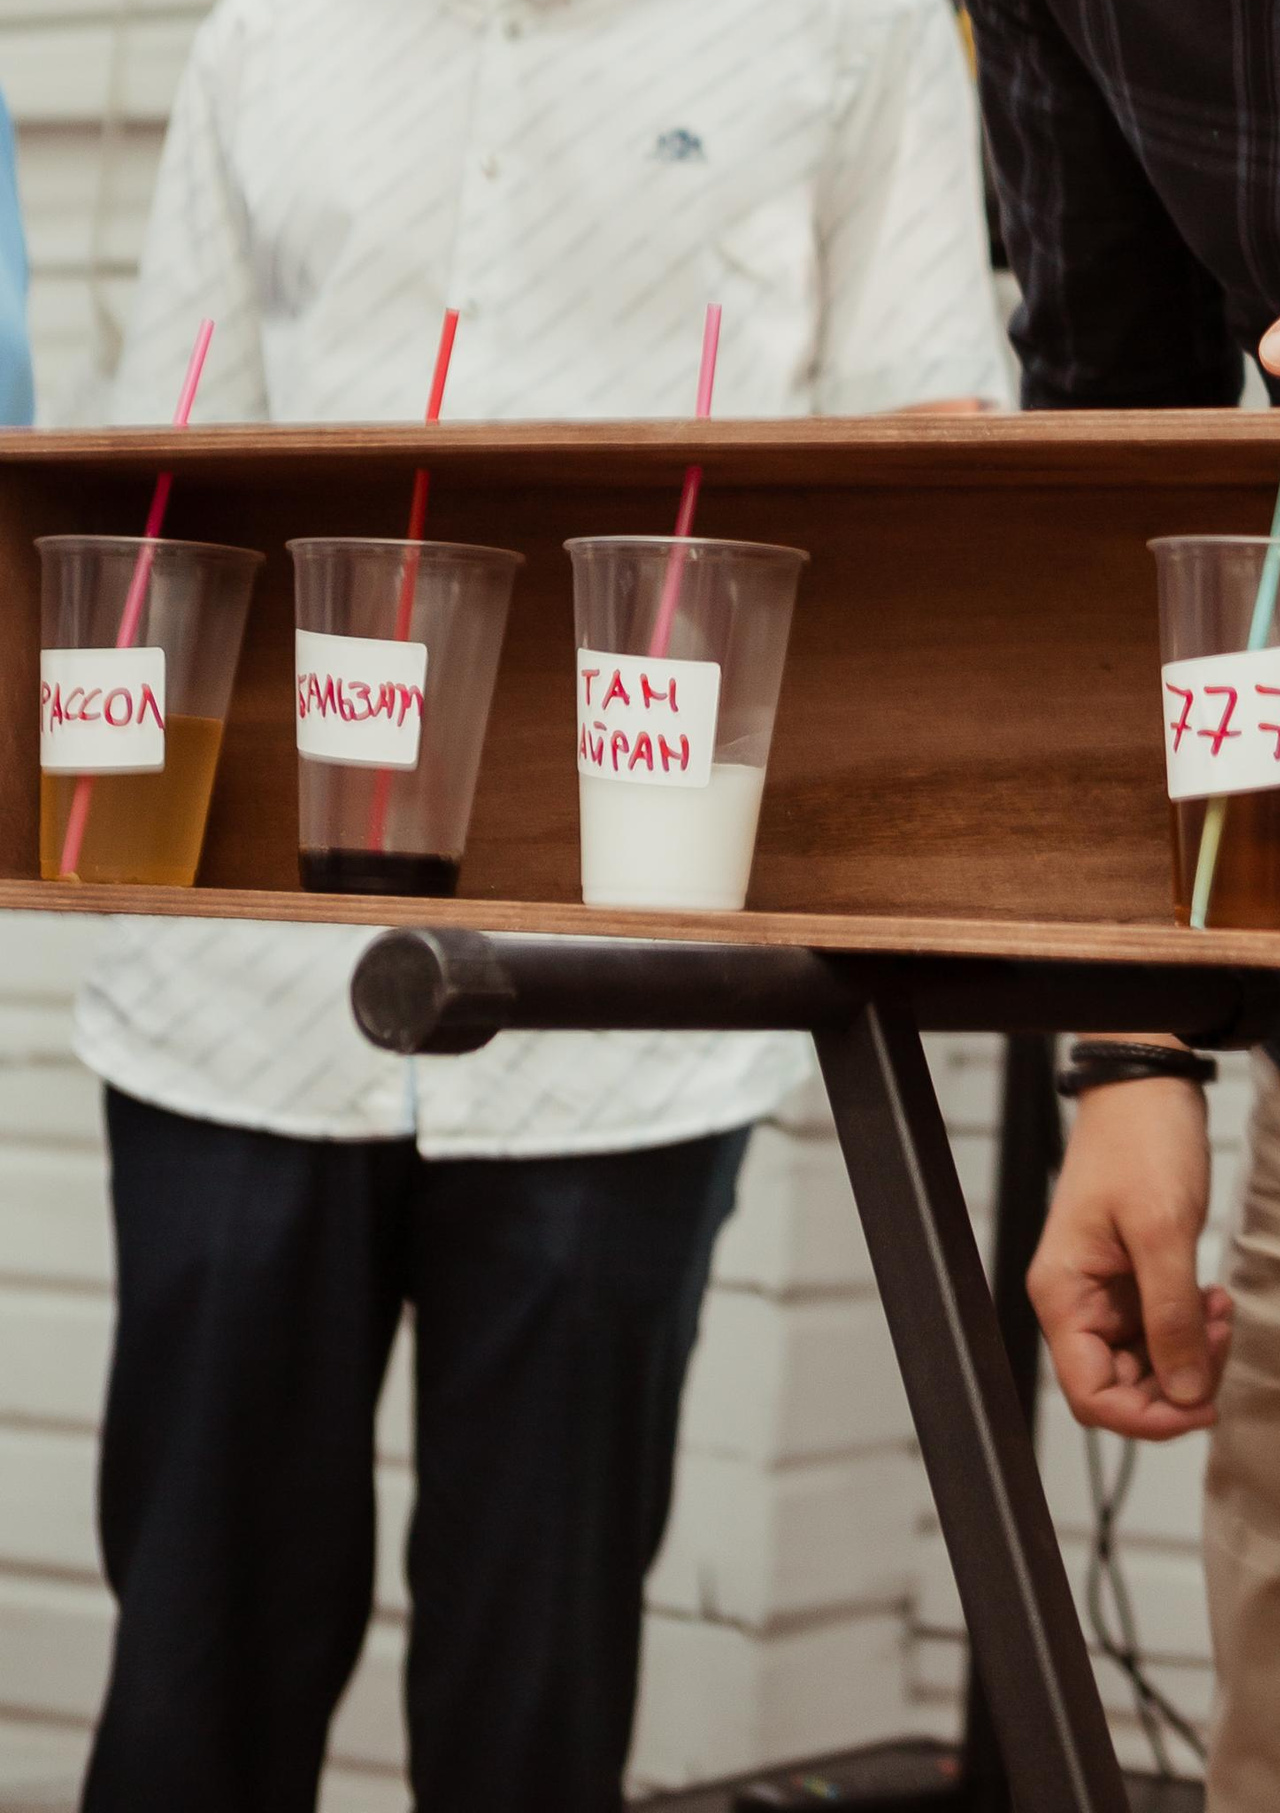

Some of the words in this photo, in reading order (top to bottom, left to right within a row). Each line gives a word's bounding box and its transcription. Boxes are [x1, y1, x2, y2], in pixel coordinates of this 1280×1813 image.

[40, 679, 165, 734] РАССОЛ
[297, 672, 425, 728] БАЛЬЗАМ
[581, 668, 679, 713] ТАН
[579, 720, 690, 772] АЙРАН
